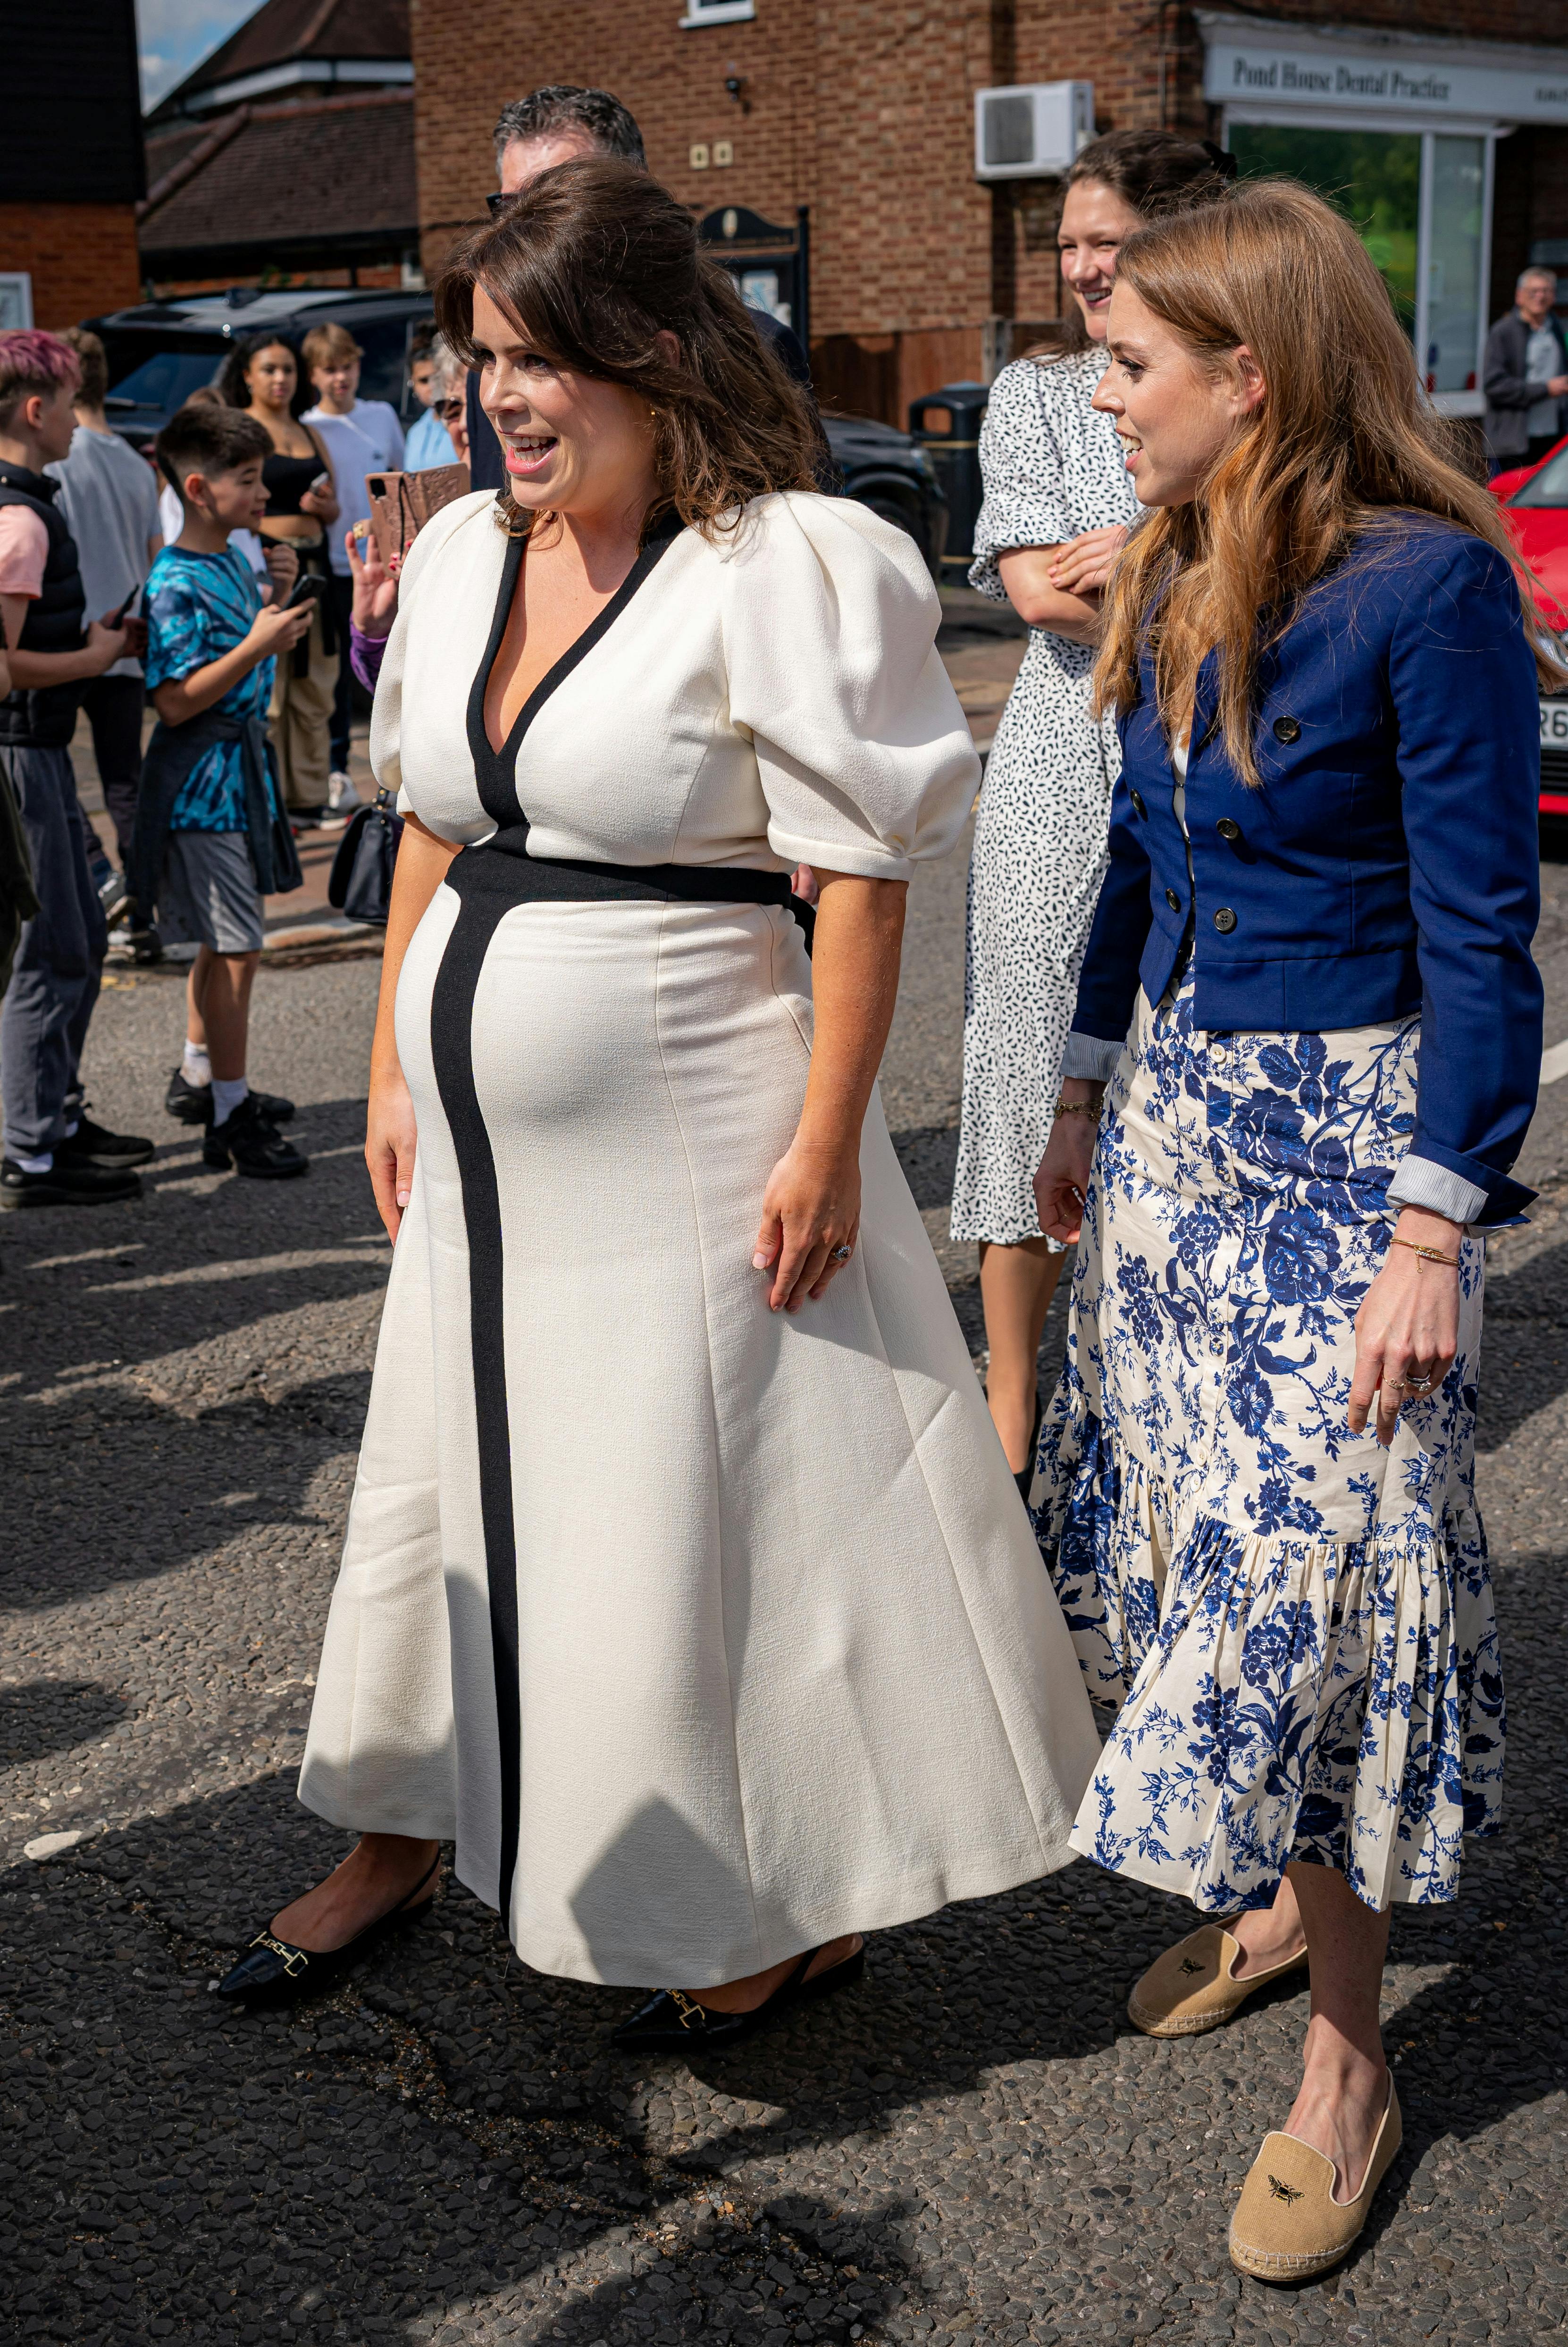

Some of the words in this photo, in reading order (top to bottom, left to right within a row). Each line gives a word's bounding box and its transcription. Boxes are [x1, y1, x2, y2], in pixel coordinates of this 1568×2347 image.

[1234, 57, 1277, 88] Pond
[1282, 60, 1332, 92] House
[1336, 65, 1388, 95] Dental
[1392, 69, 1450, 101] Practice
